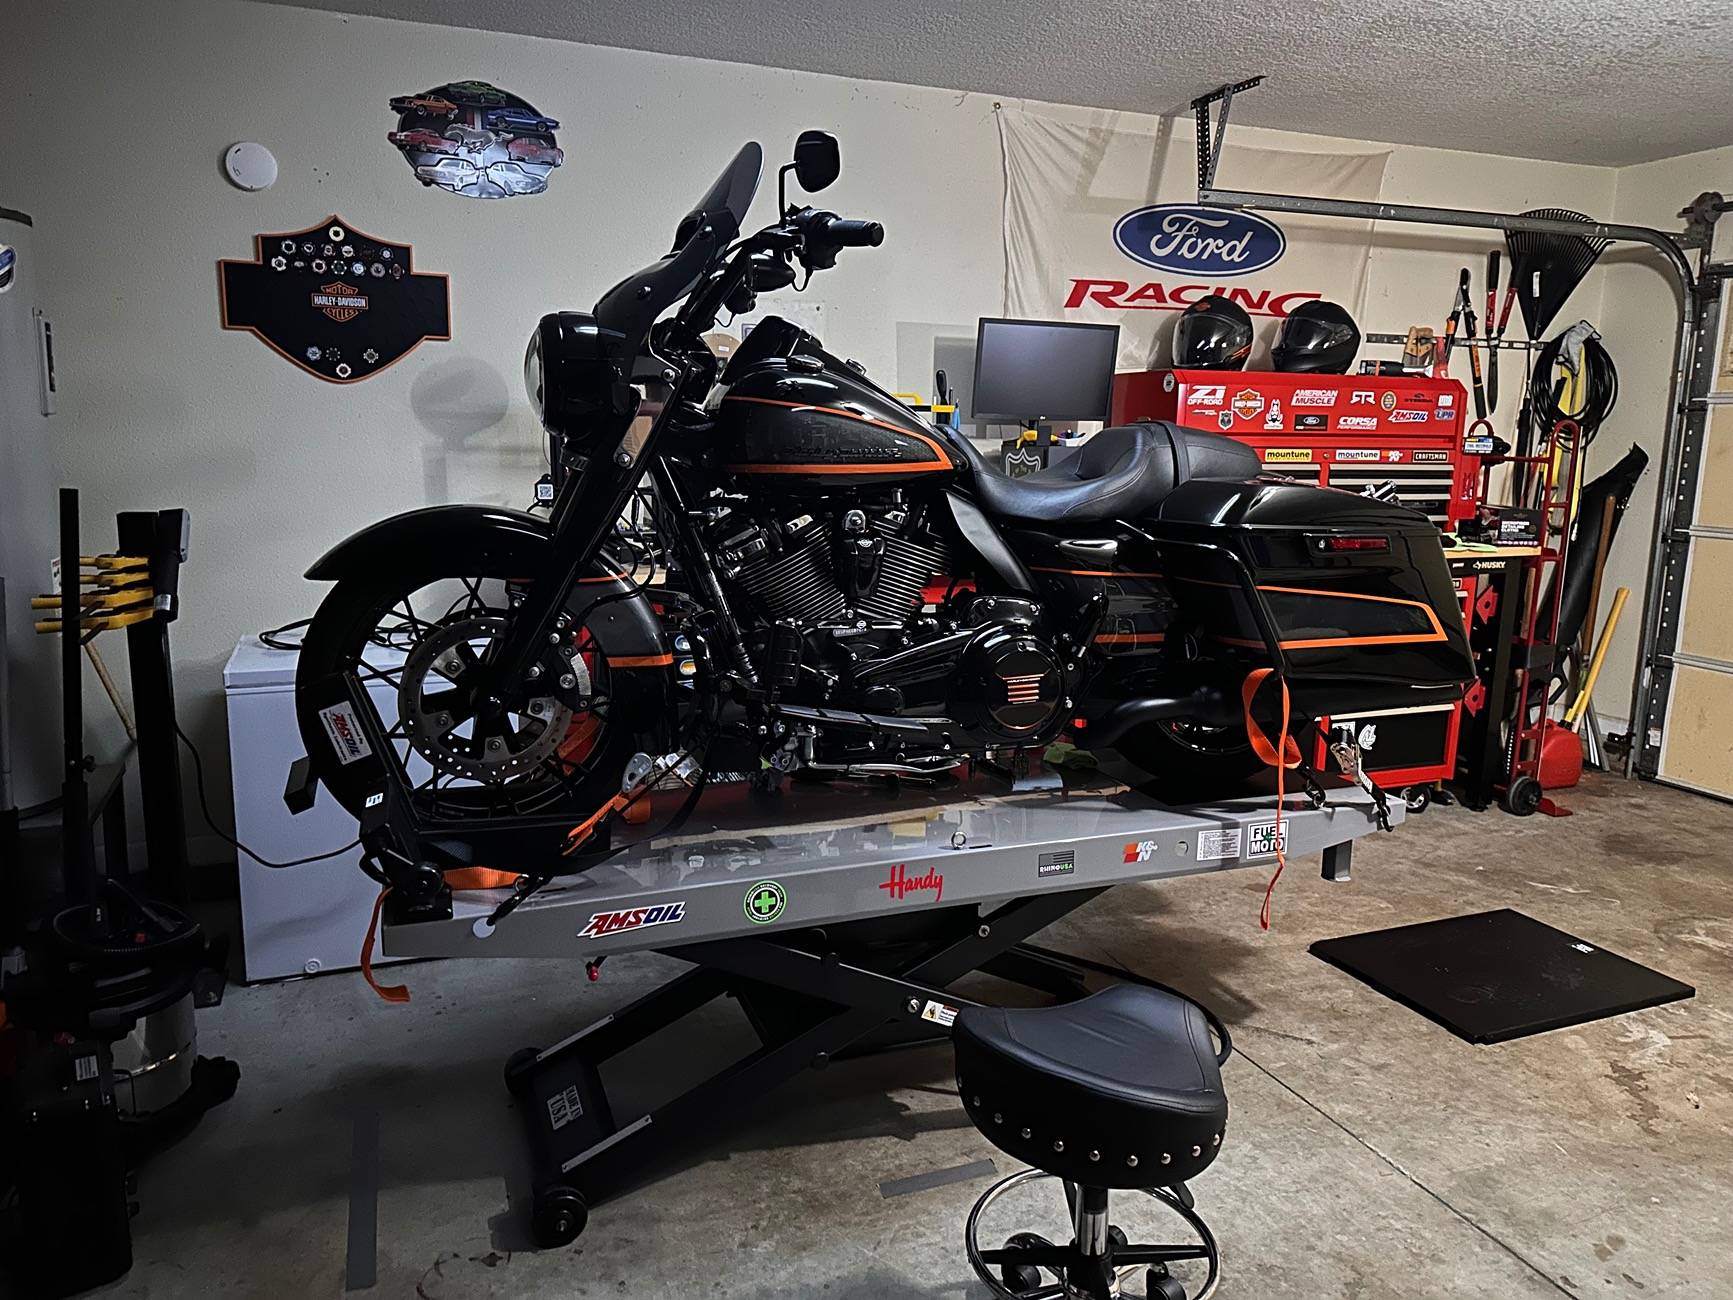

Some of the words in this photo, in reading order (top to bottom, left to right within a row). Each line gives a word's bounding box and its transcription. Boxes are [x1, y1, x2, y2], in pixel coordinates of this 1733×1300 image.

[1150, 213, 1253, 262] Ford
[325, 285, 354, 295] MOTOR
[314, 296, 366, 307] HARLEY-DAVIDSON
[326, 308, 355, 319] CYCLES
[1294, 389, 1339, 398] AMERICAN
[1294, 397, 1333, 405] MUSCLE
[1389, 410, 1428, 421] AMSOIL
[1339, 416, 1377, 426] CORSA
[1267, 450, 1310, 458] mountune
[1338, 451, 1378, 459] mountune
[1481, 561, 1506, 569] HUSKY
[879, 863, 943, 902] Handy
[581, 903, 685, 937] AMSOIL
